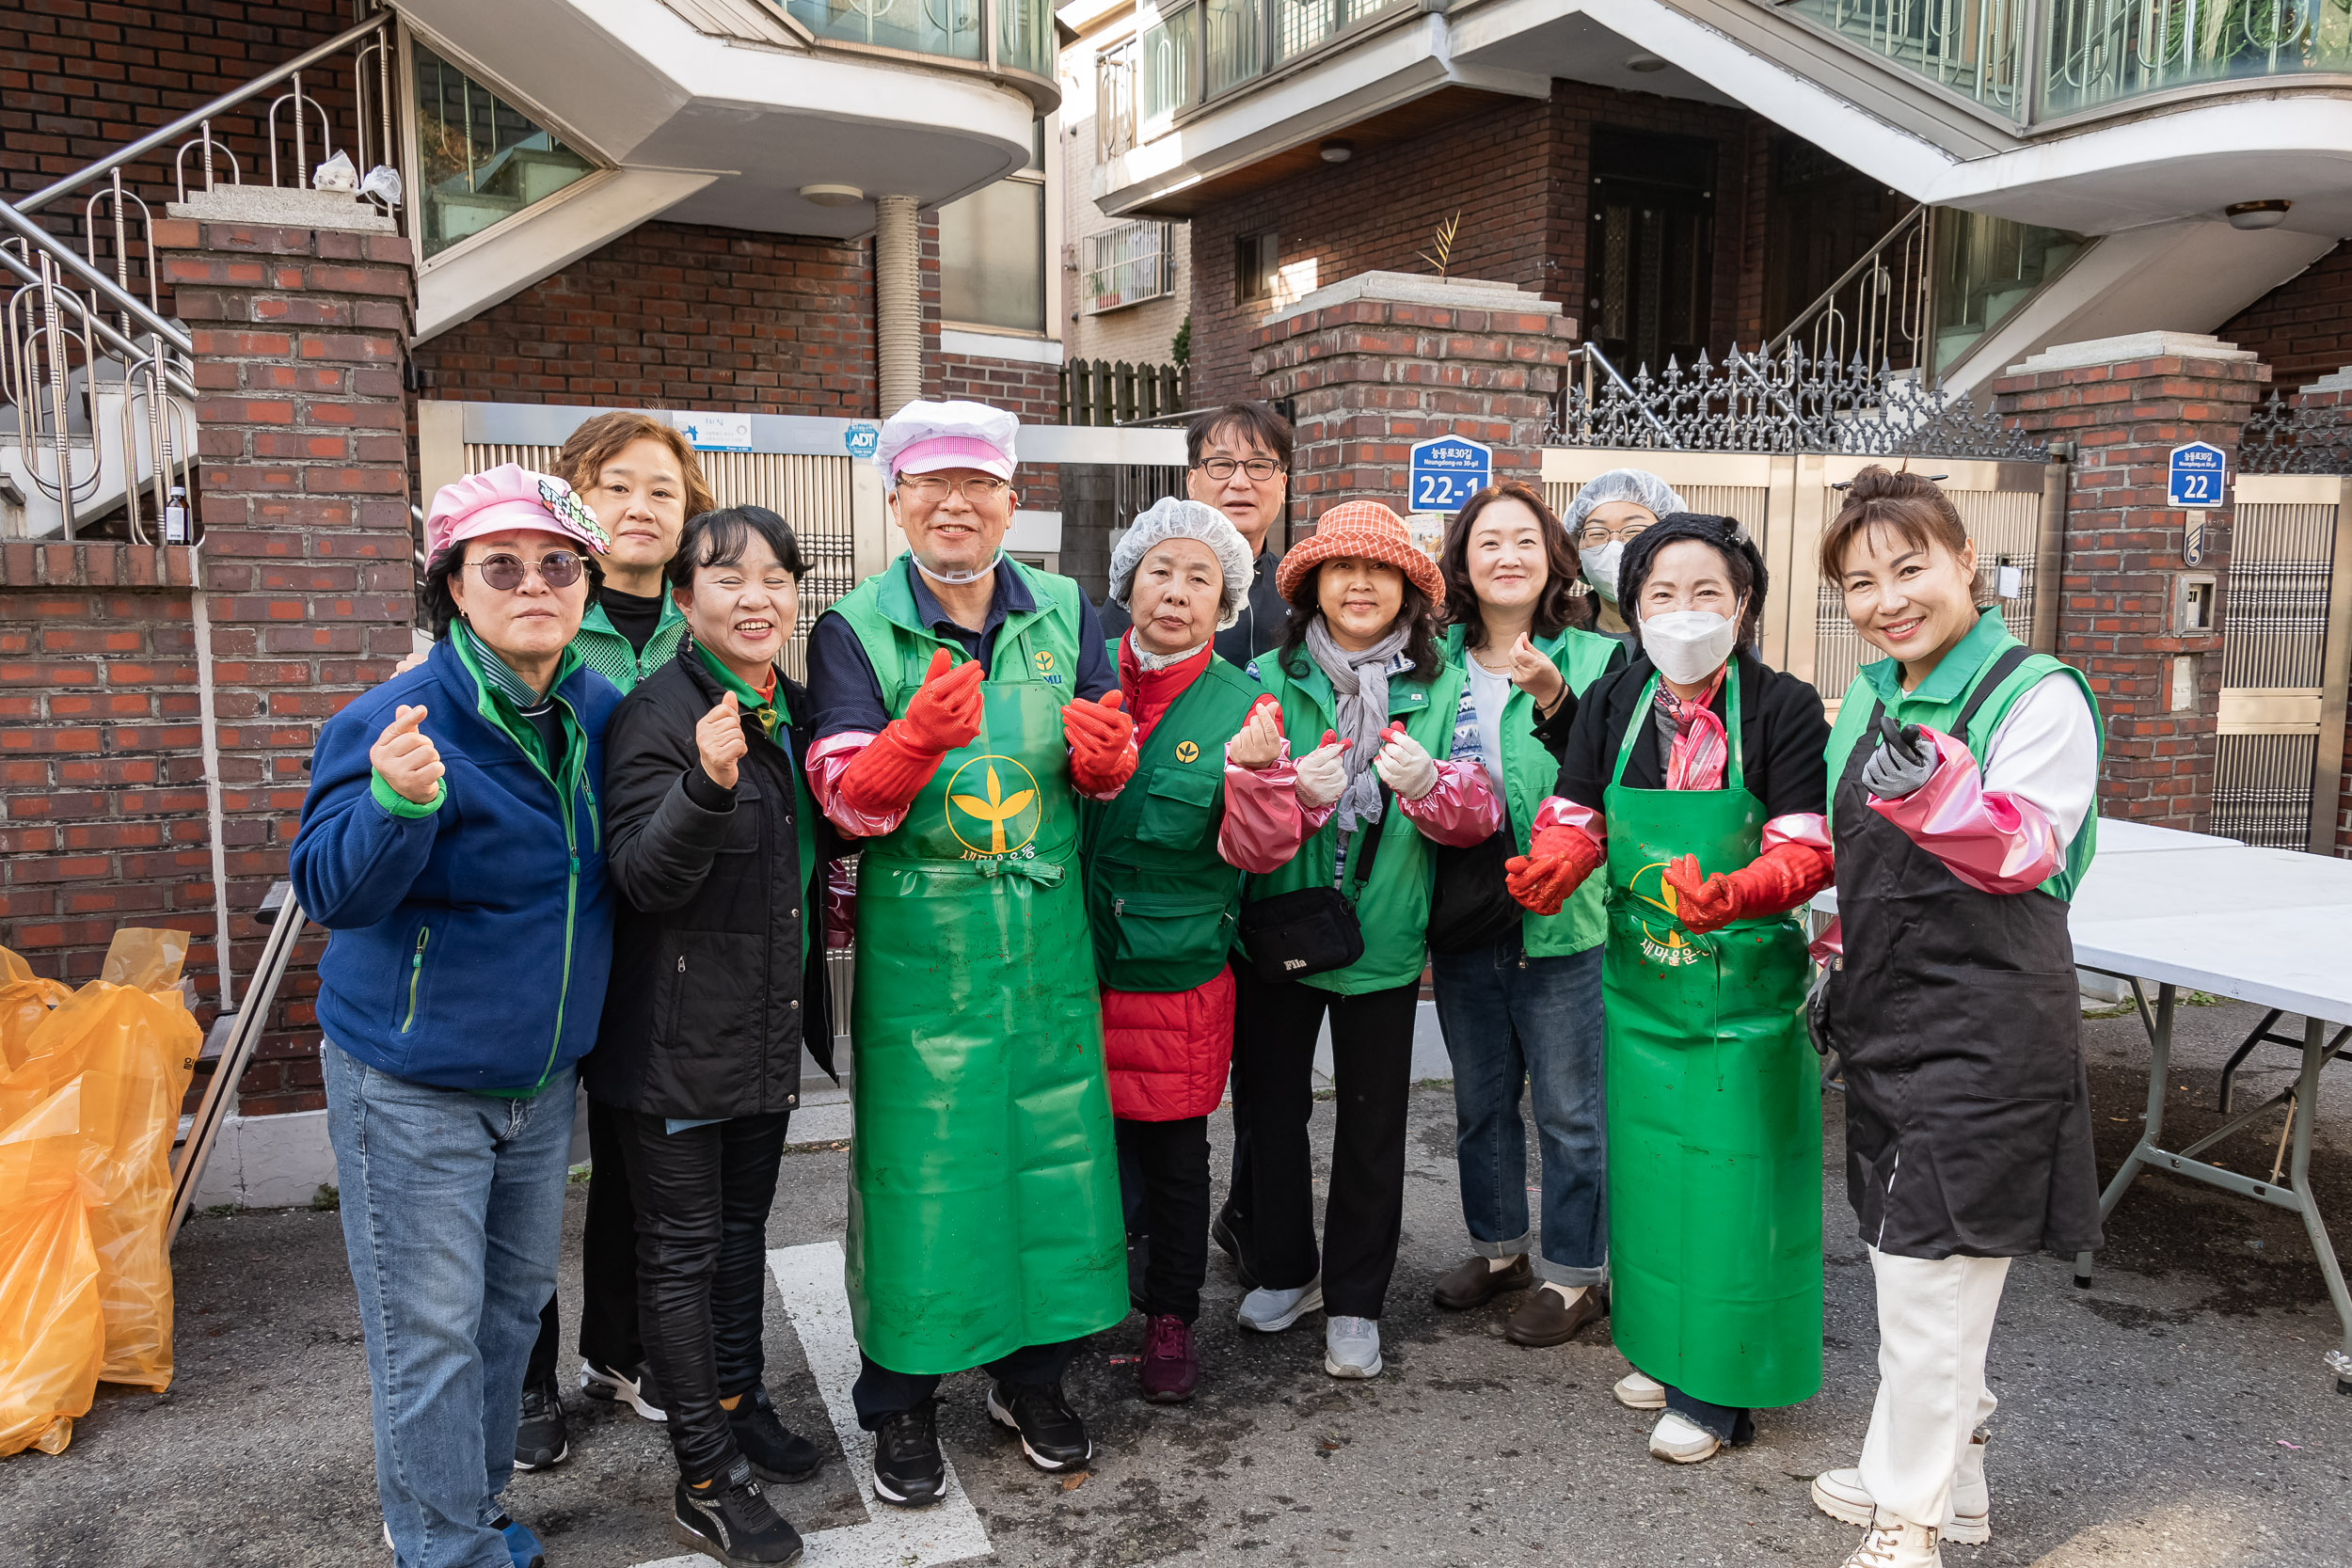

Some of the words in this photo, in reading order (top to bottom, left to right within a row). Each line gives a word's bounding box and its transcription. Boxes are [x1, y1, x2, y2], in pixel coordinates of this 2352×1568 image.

[850, 433, 875, 448] ADT
[1431, 447, 1472, 460] 능동로30길
[2184, 451, 2213, 462] 능동로30길
[1423, 458, 1463, 467] Neungdong-ro
[1419, 475, 1479, 504] 22-1
[2184, 475, 2208, 499] 22
[1639, 938, 1709, 967] 새마을운
[1283, 958, 1307, 971] Fila
